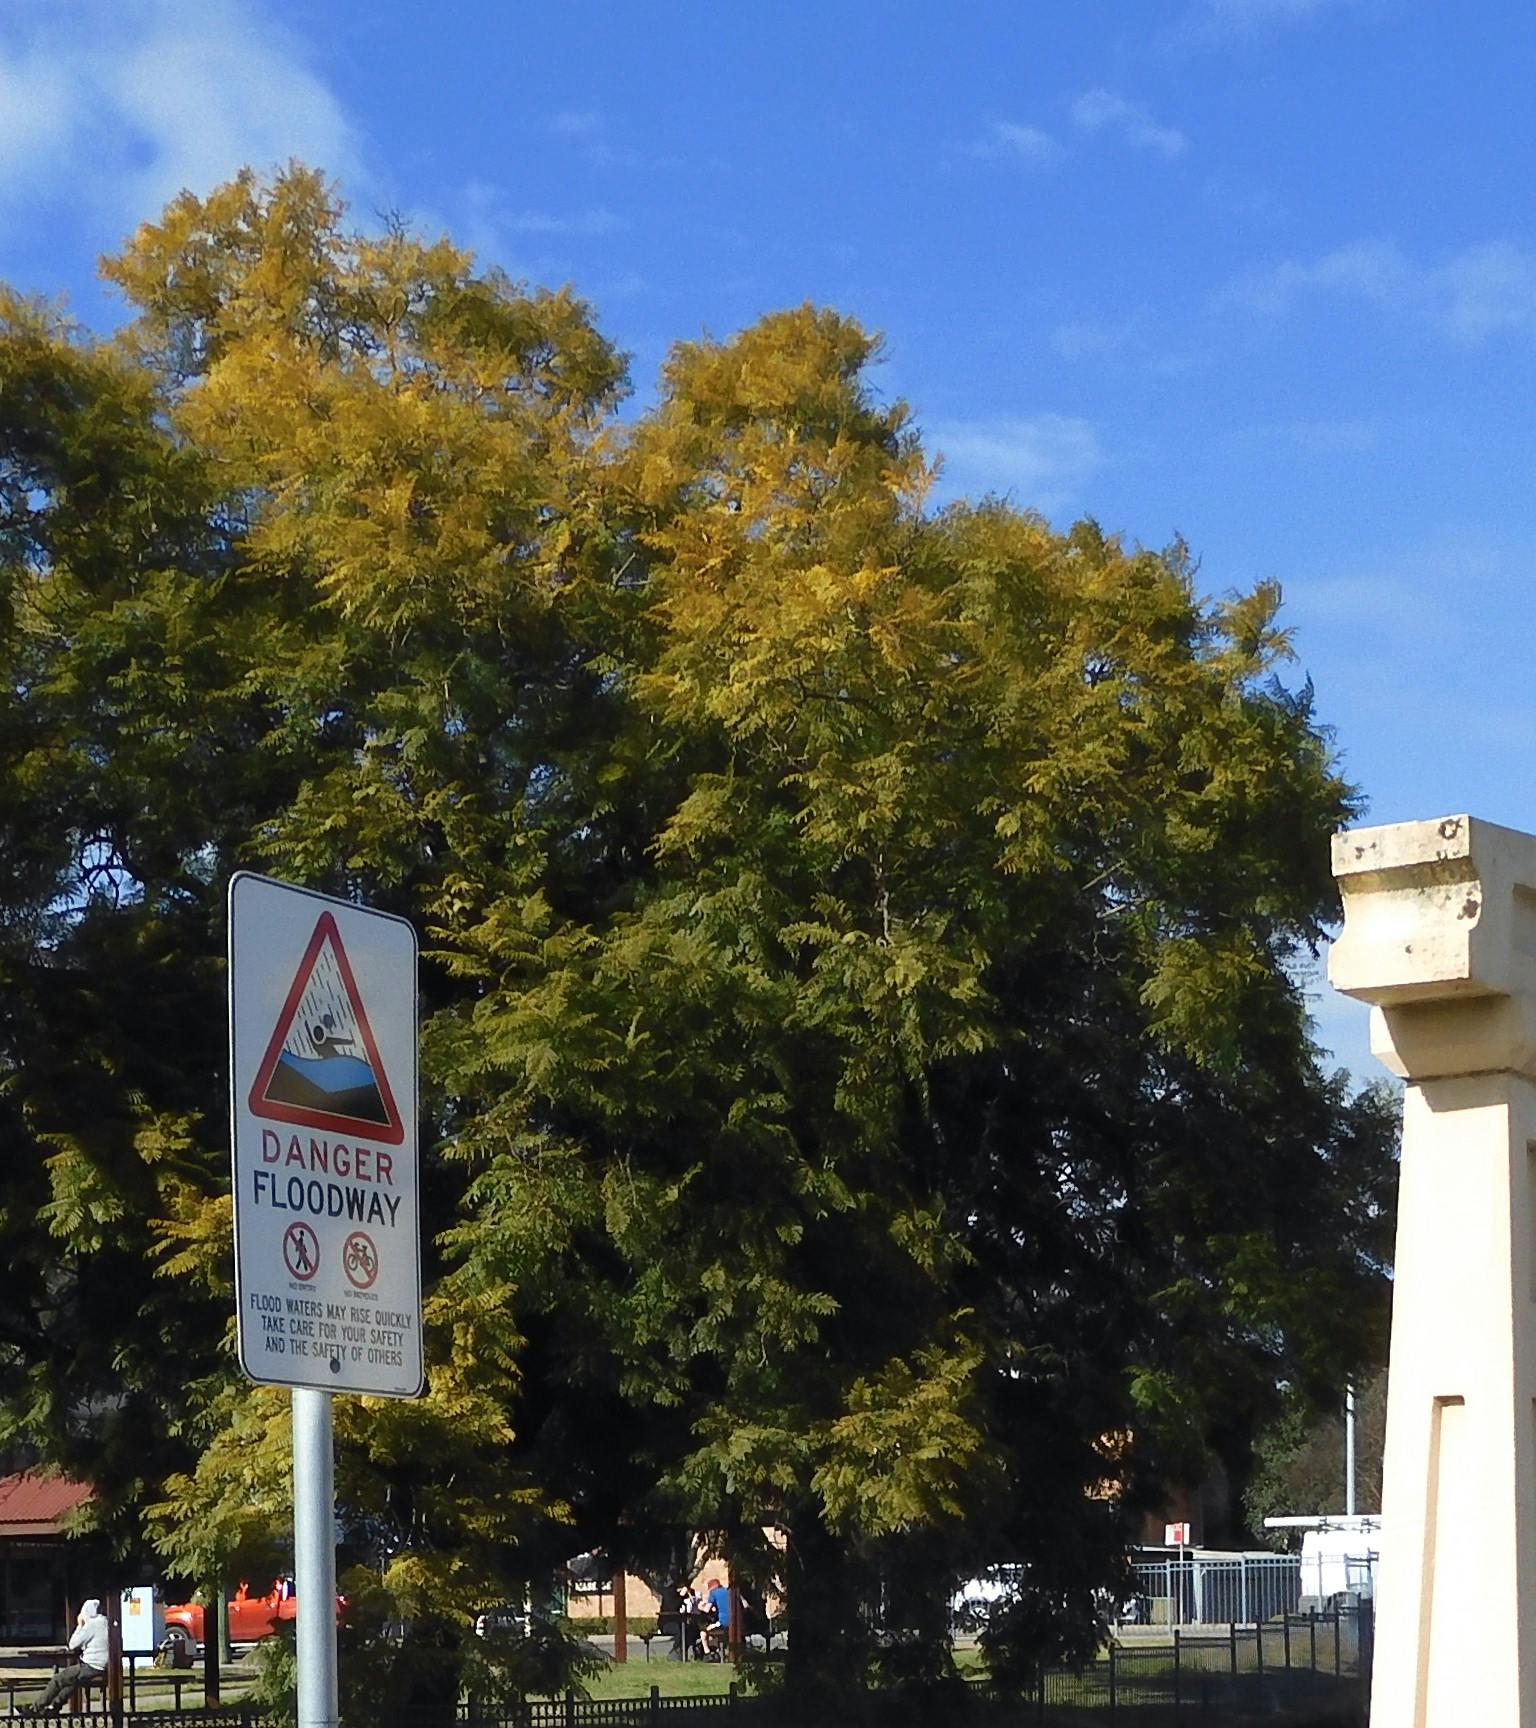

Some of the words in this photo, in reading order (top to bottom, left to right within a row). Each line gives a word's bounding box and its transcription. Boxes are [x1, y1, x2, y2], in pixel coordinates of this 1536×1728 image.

[262, 1129, 393, 1186] DANGER
[253, 1170, 402, 1227] FLOODWAY
[250, 1293, 282, 1313] FLOOD
[286, 1298, 323, 1318] WATERS
[326, 1304, 347, 1321] MAY
[350, 1307, 371, 1324] RISE
[375, 1310, 412, 1329] QUICKLY
[261, 1315, 286, 1333] TAKE
[289, 1318, 314, 1337] CARE
[318, 1323, 337, 1339] FOR
[341, 1325, 366, 1344] YOUR
[370, 1329, 404, 1347] SAFETY
[265, 1336, 286, 1353] AND
[290, 1338, 308, 1356] THE
[313, 1341, 346, 1361] SAFETY
[351, 1346, 364, 1362] OF
[368, 1348, 402, 1367] OTHERS
